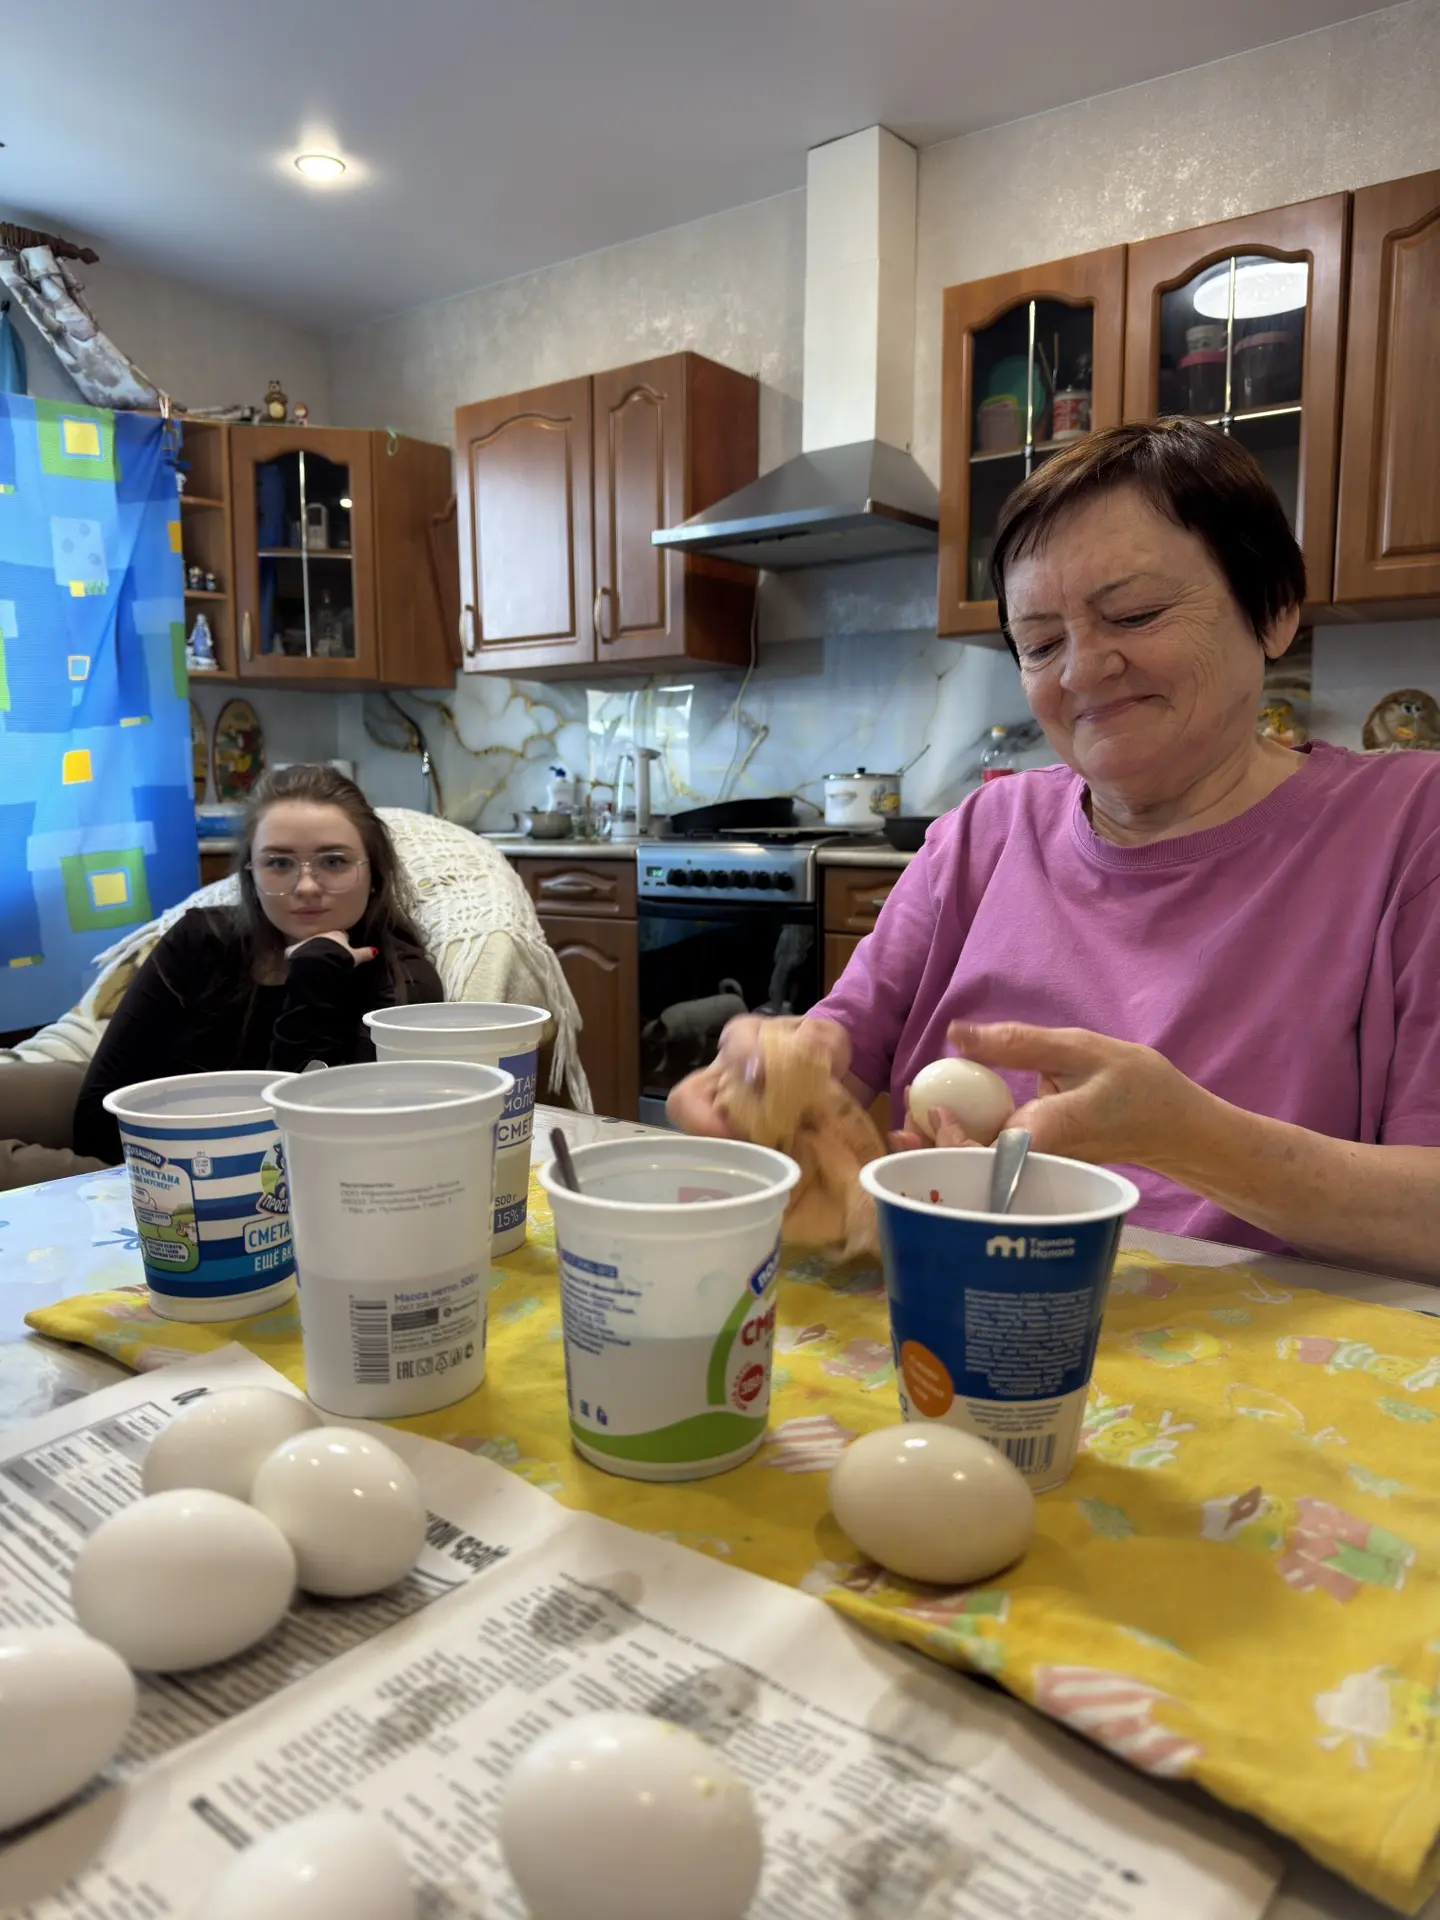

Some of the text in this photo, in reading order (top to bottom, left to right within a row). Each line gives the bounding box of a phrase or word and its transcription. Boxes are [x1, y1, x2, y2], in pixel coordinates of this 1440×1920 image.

[262, 1194, 290, 1213] ПРОСТ
[495, 1193, 512, 1207] 500
[496, 1208, 520, 1229] 15%
[248, 1221, 292, 1248] СМЕТА
[254, 1248, 279, 1272] ЕЩЁ
[394, 1291, 429, 1304] Масса
